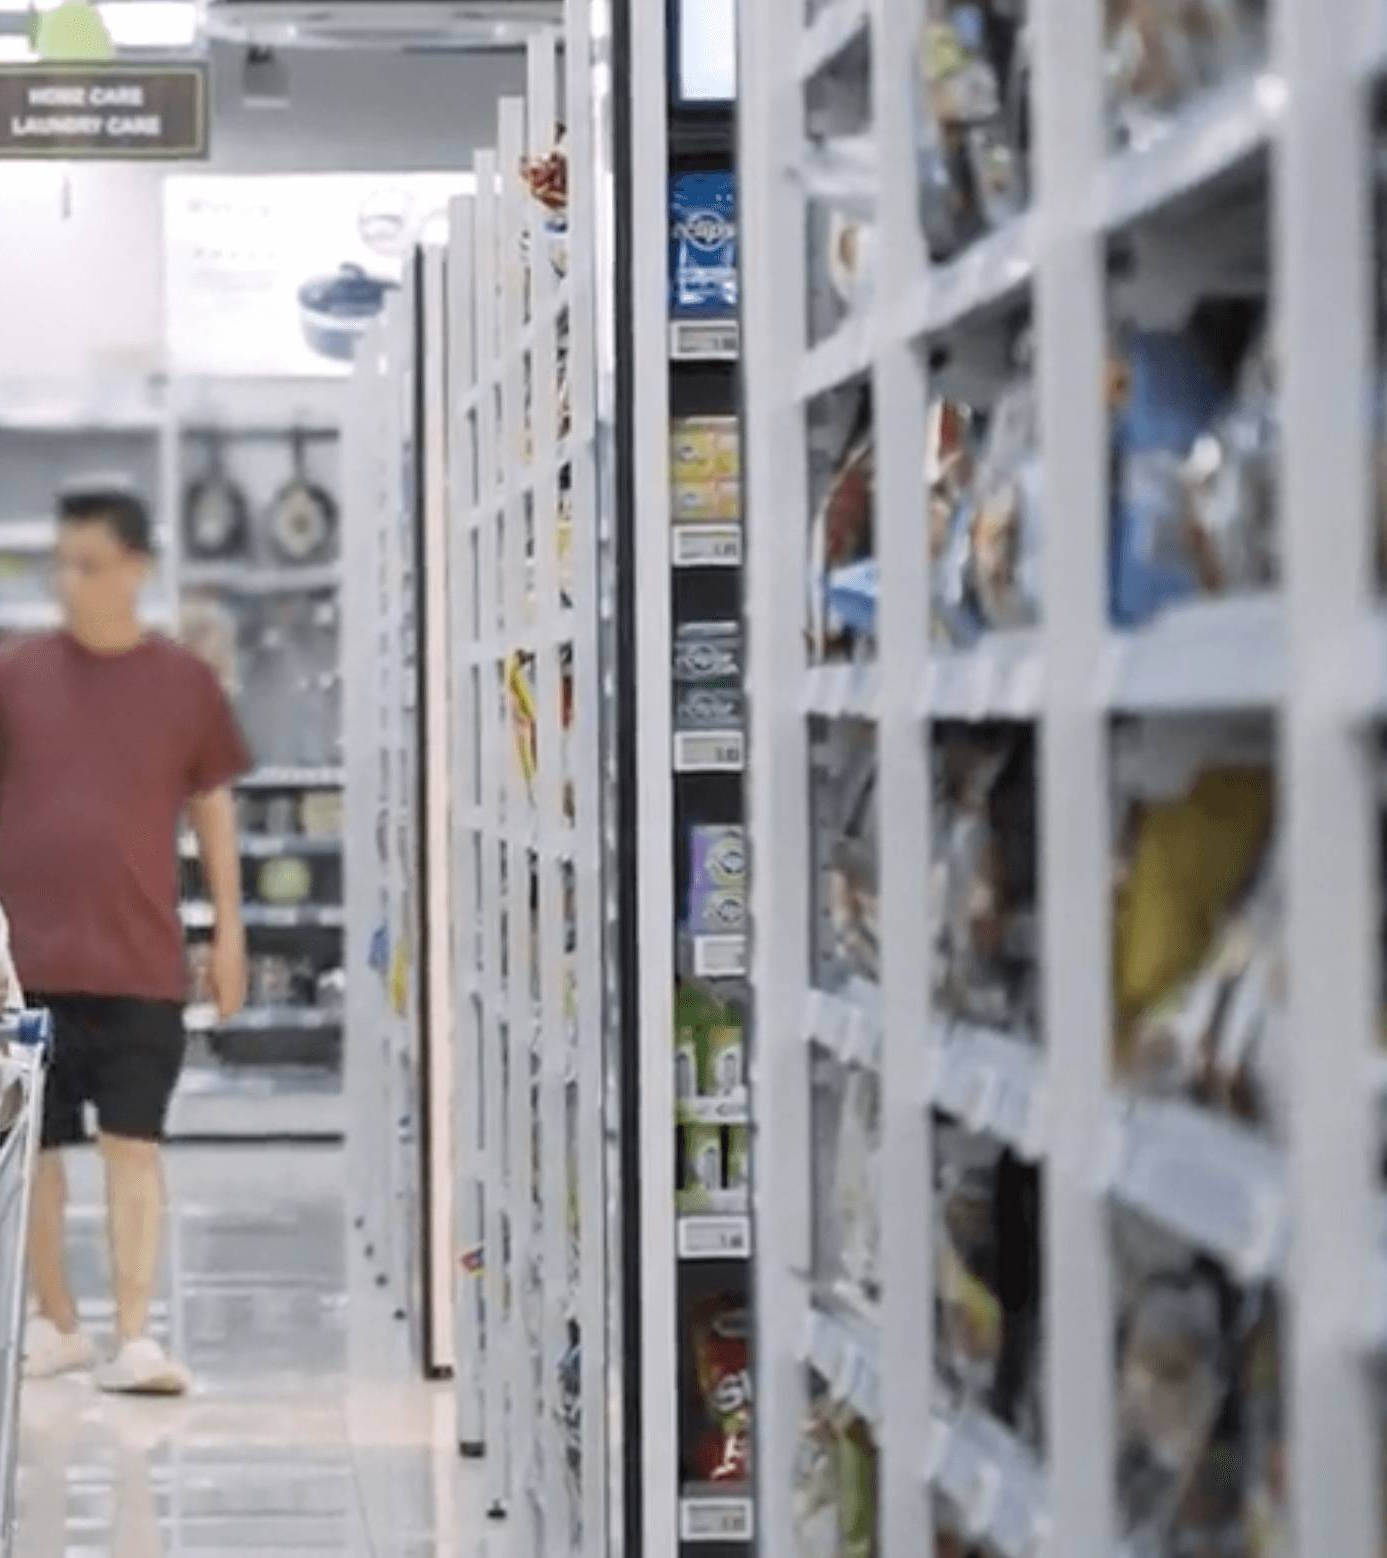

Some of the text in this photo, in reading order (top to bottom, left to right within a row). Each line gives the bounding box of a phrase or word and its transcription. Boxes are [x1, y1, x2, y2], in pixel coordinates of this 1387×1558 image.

[28, 86, 143, 106] HOME CARE
[12, 115, 161, 136] LAUNDRY CARE
